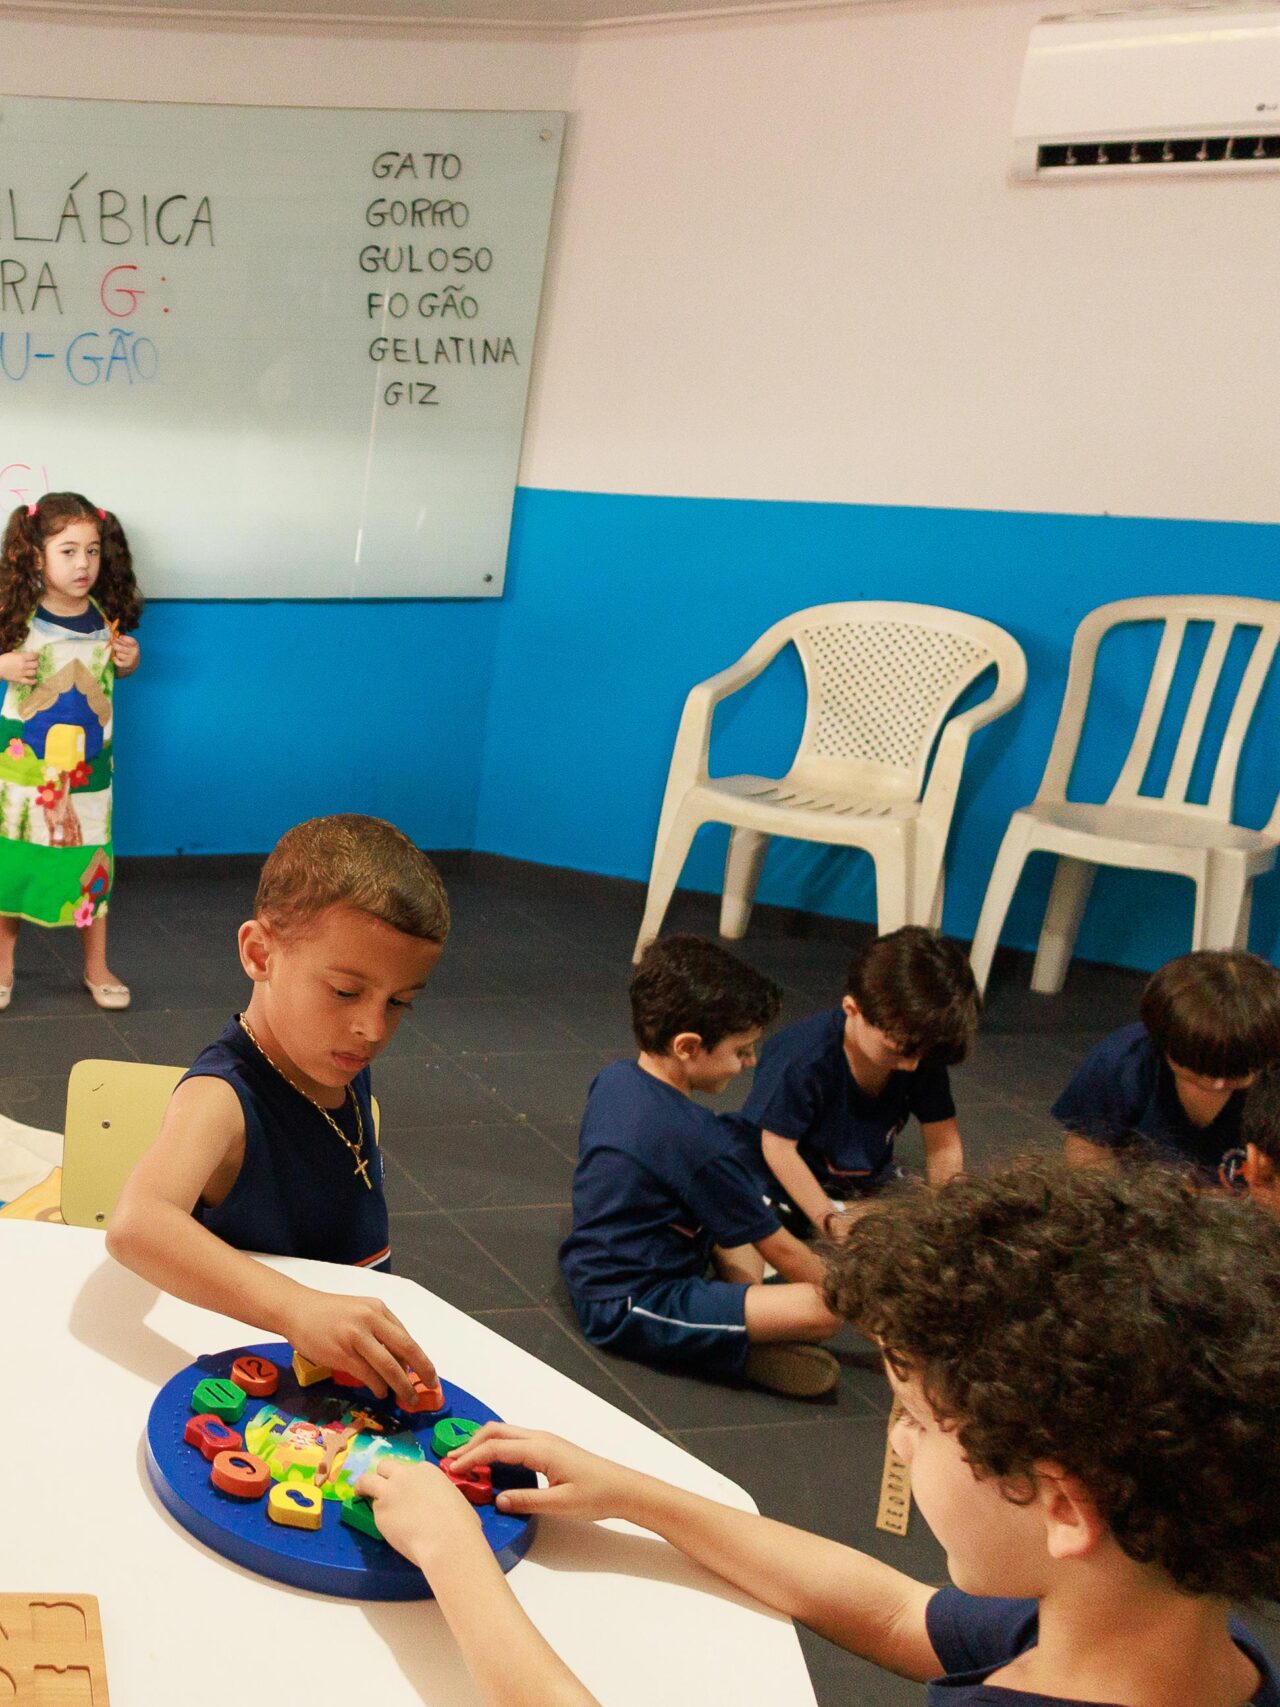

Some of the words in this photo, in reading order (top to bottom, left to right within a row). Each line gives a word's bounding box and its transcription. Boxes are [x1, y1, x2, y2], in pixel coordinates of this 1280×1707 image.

[372, 151, 462, 180] GATO
[365, 198, 469, 227] GORRO
[359, 245, 493, 273] GULOSO
[368, 284, 480, 319] FOGÃO
[369, 336, 520, 366] GELATINA
[383, 381, 440, 406] GIZ
[235, 1359, 274, 1381] 12
[204, 1382, 236, 1404] 11
[196, 1421, 231, 1442] 10
[228, 1456, 257, 1476] 9
[285, 1488, 315, 1508] 8
